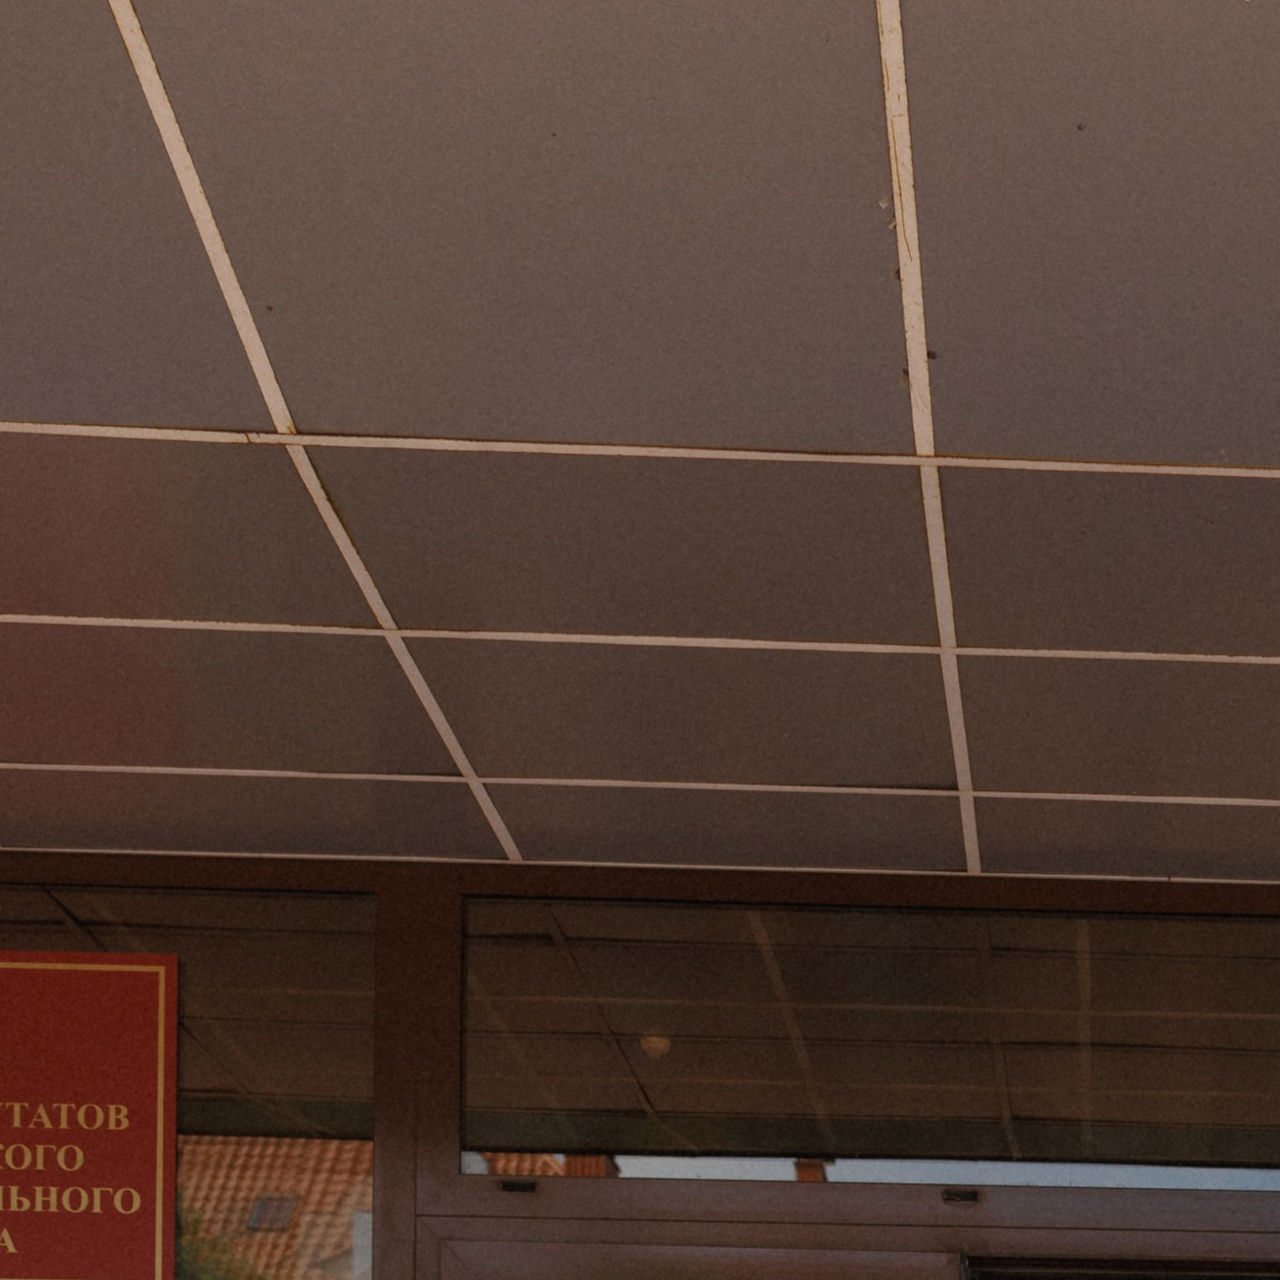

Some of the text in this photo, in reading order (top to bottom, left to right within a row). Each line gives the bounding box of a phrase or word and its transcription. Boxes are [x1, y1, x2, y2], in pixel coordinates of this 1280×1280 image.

[0, 1102, 130, 1130] ТАТОВ
[0, 1143, 84, 1172] ОГО
[0, 1185, 141, 1215] ЬНОГО
